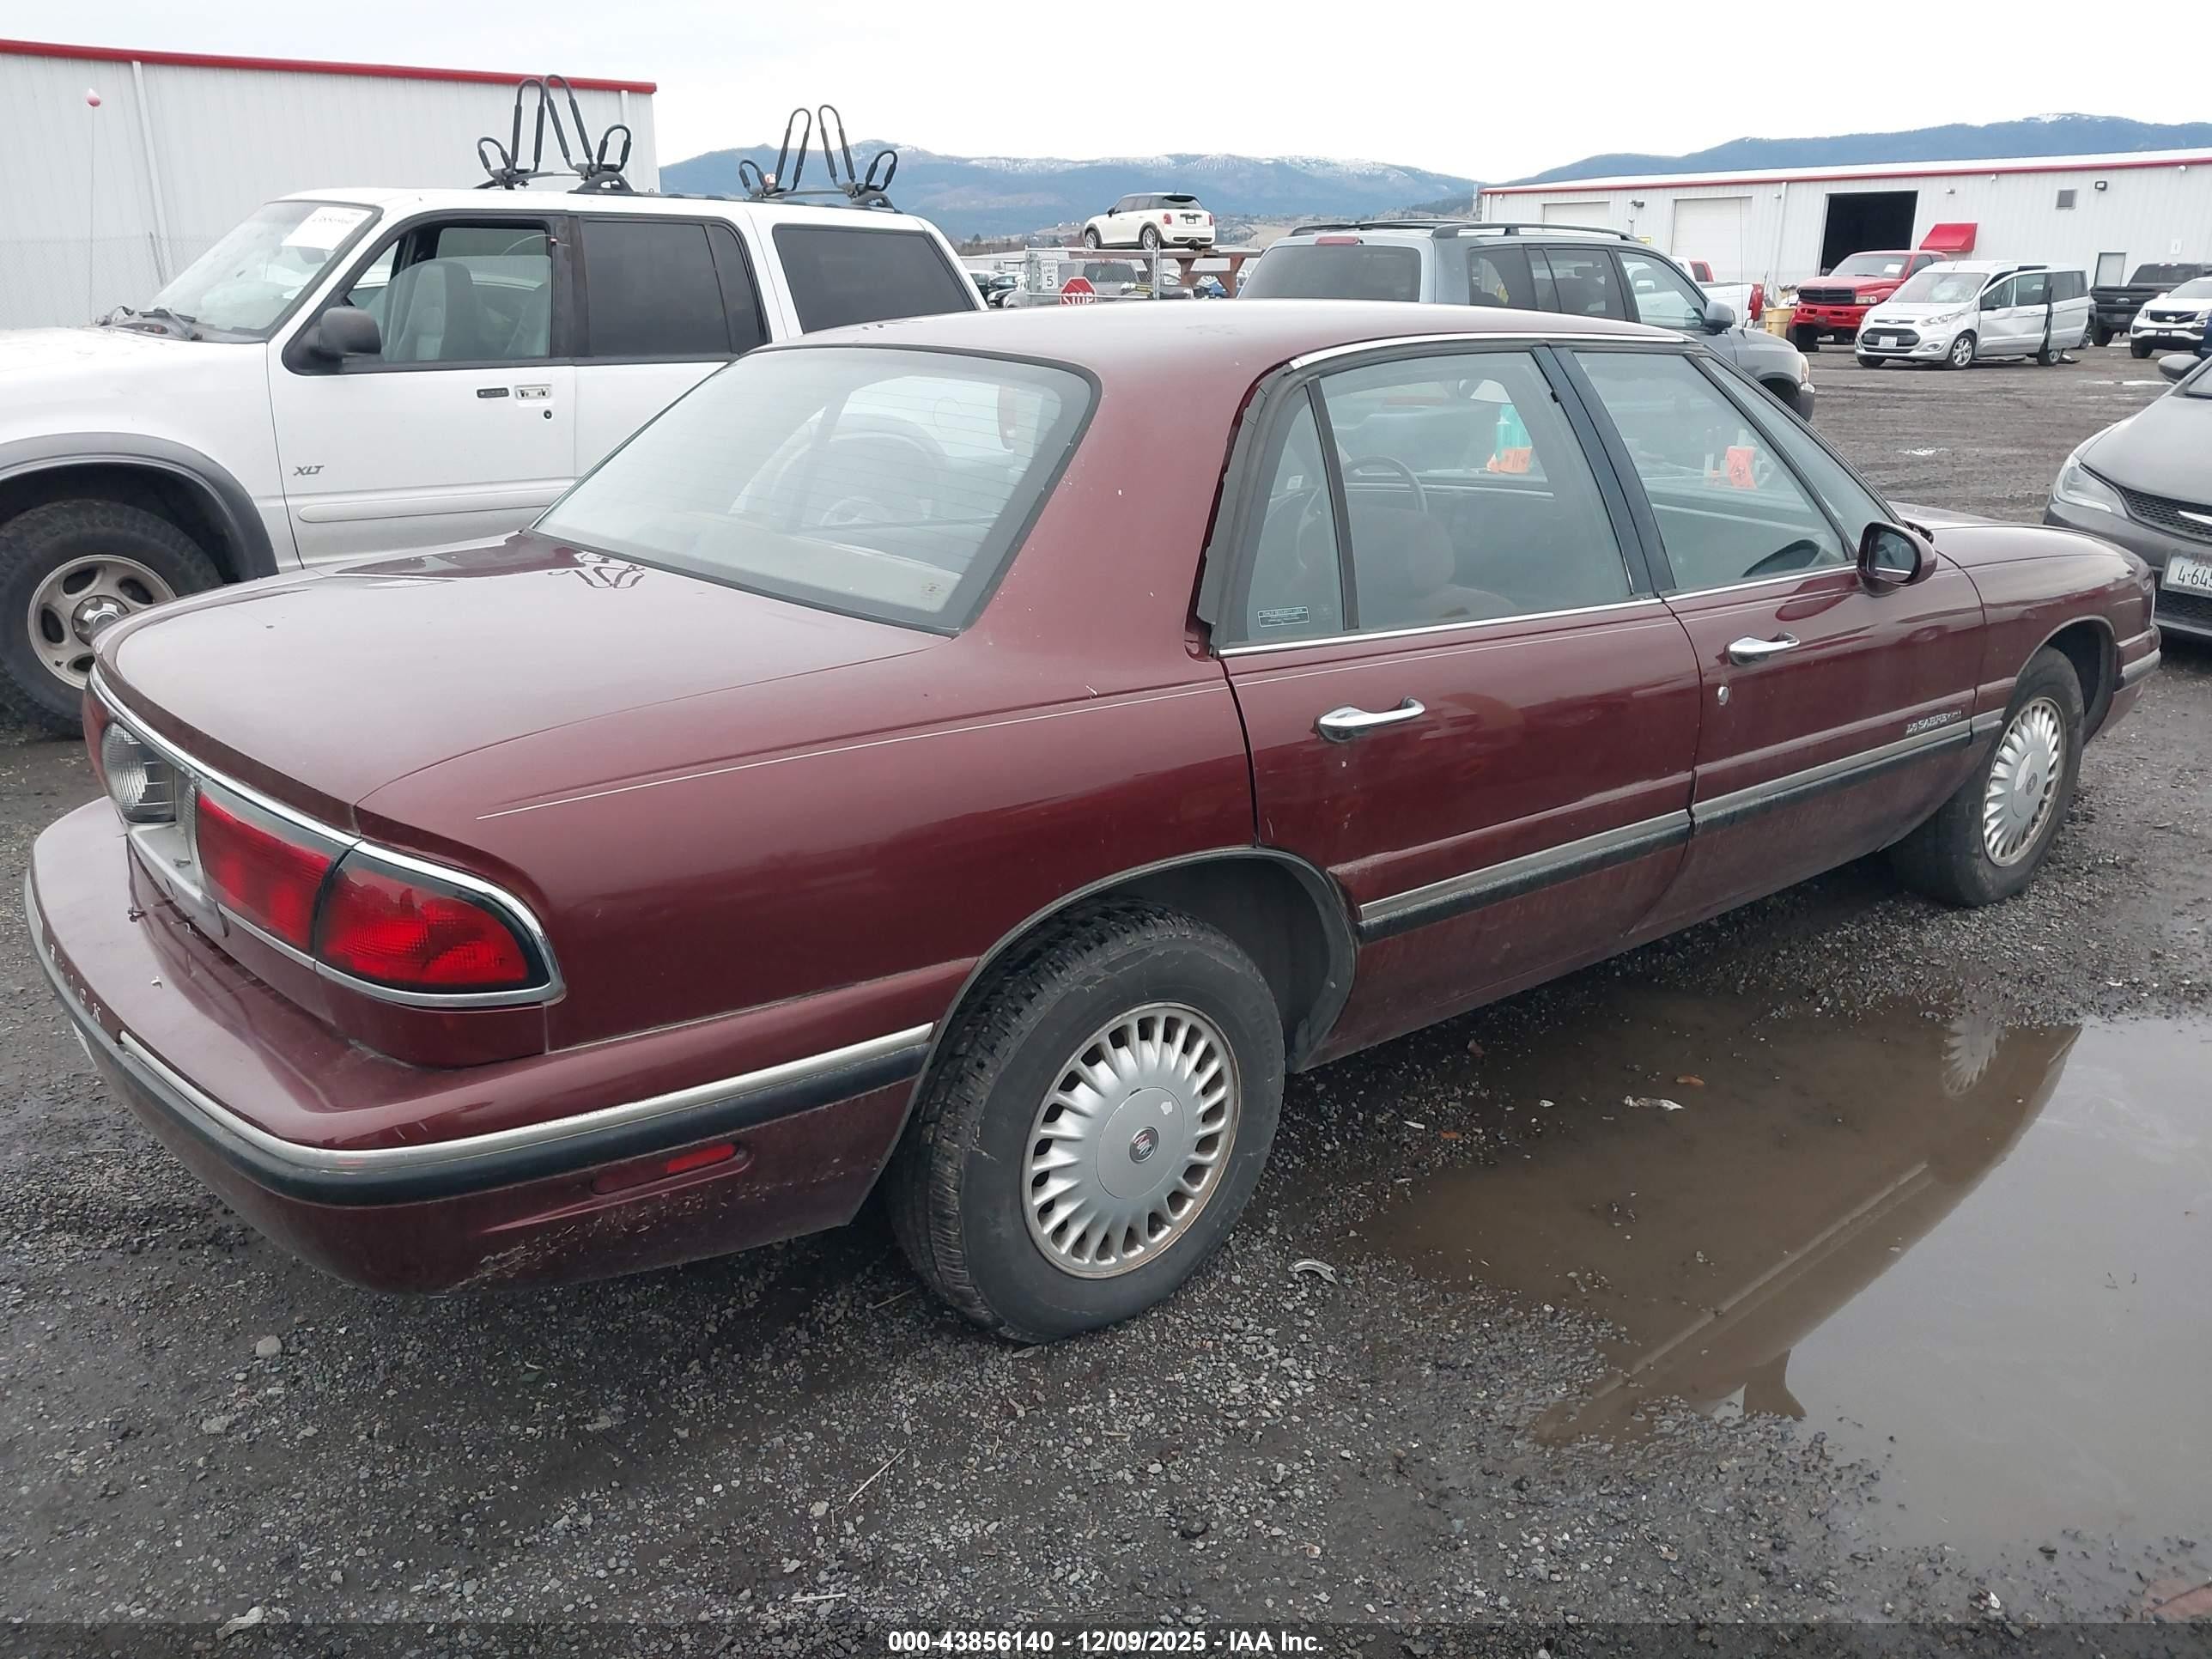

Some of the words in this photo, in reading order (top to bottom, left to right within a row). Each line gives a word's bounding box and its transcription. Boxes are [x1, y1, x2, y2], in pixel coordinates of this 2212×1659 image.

[1046, 275, 1054, 287] 5
[1062, 292, 1095, 305] STOP
[293, 464, 325, 477] XLT
